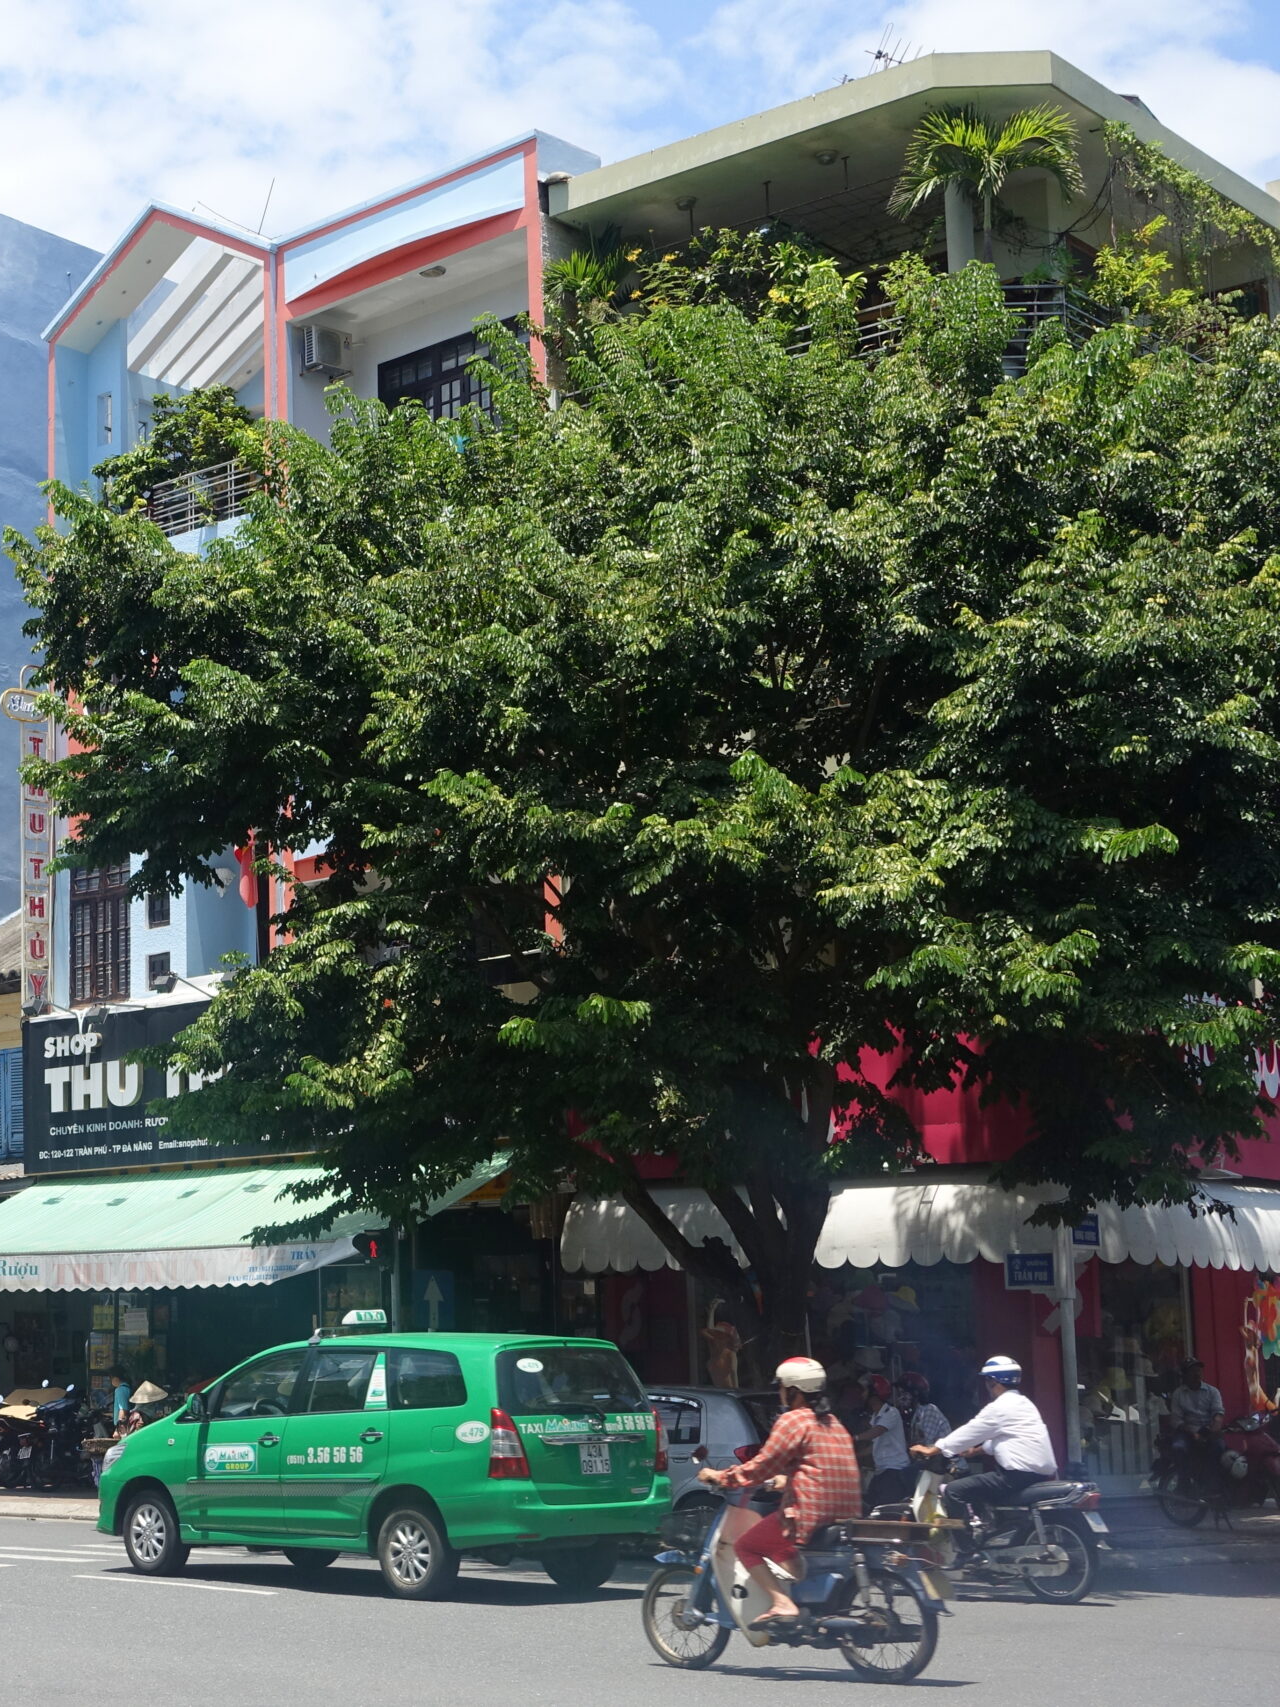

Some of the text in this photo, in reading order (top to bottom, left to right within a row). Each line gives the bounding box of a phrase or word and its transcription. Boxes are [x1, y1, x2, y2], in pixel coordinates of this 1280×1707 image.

[43, 1032, 97, 1058] SHOP
[44, 1060, 140, 1113] THU
[49, 1123, 84, 1136] CHUYÊN
[86, 1122, 107, 1132] KINH
[109, 1119, 143, 1131] DOANH:
[112, 1144, 122, 1153] TP
[355, 1310, 385, 1321] TAXI
[519, 1423, 544, 1434] TAXI
[286, 1446, 364, 1465] (0511) 3.56 56 56
[586, 1443, 604, 1458] 43A
[582, 1459, 610, 1474] 091.15
